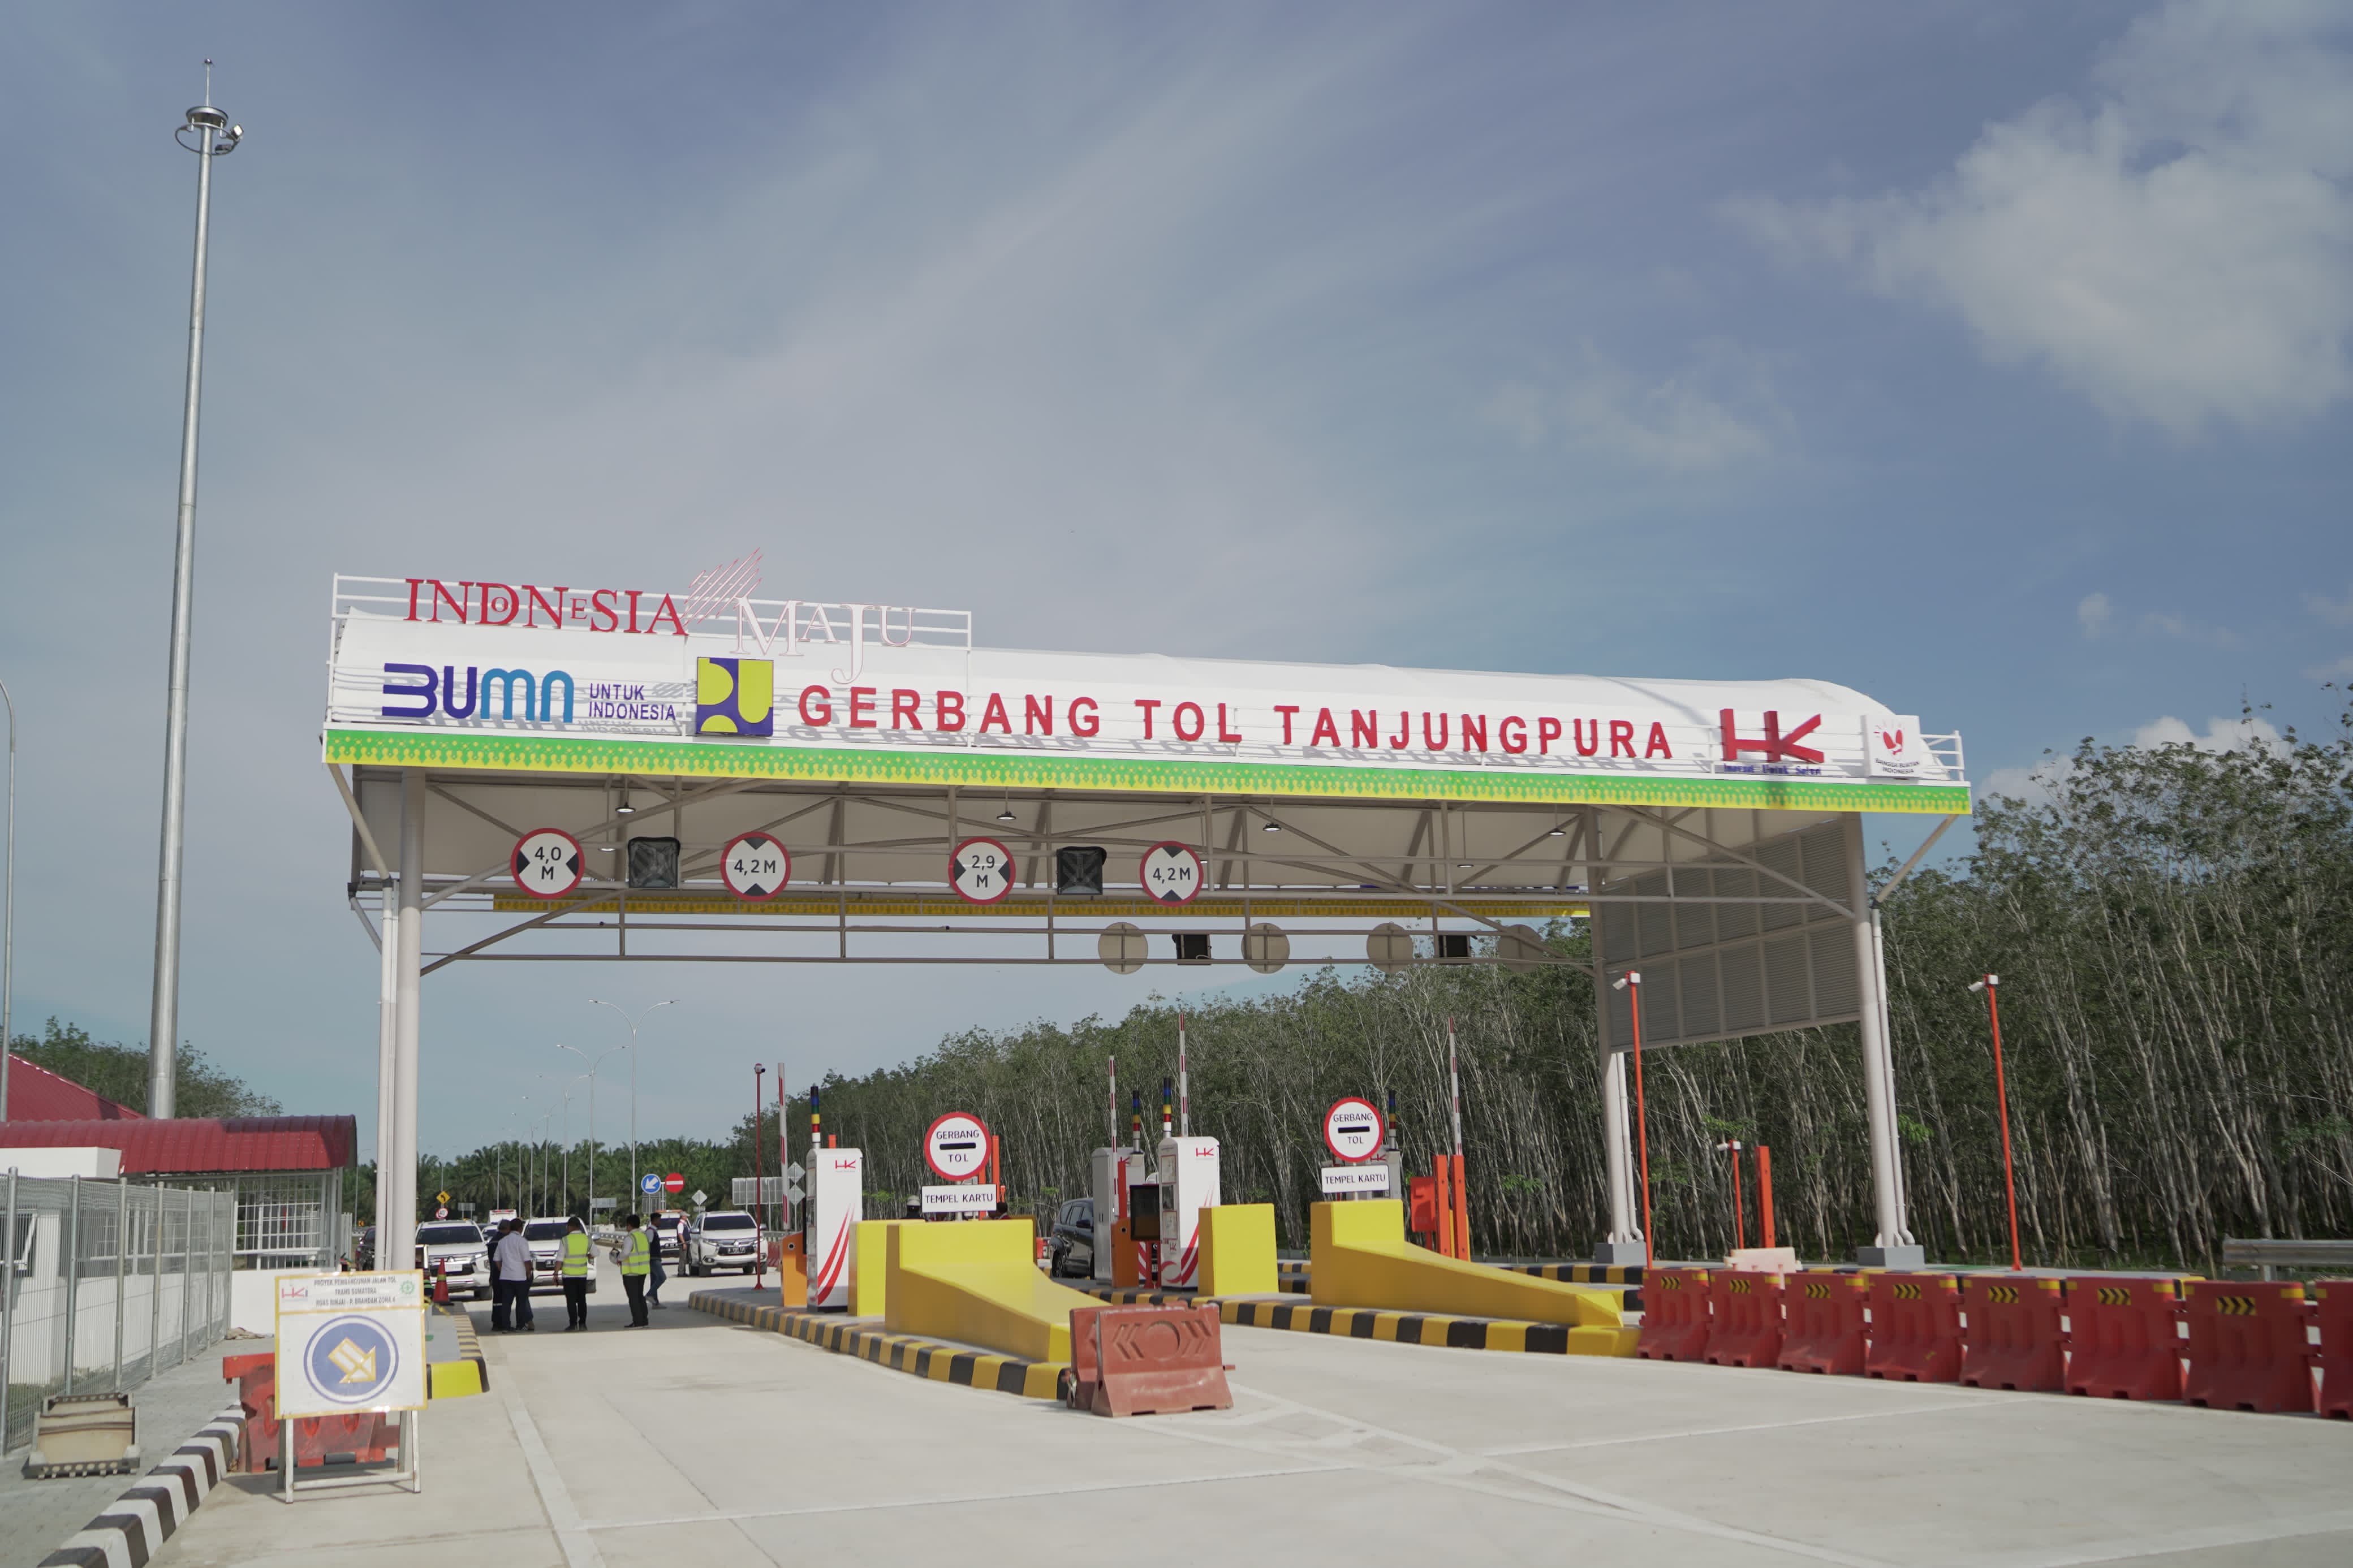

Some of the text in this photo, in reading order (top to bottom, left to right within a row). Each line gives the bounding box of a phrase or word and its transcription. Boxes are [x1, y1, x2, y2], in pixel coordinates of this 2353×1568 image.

[403, 578, 916, 684] INDONESIA MAJU
[589, 683, 645, 701] UNTUK
[589, 701, 676, 720] INDONESIA
[798, 685, 1673, 759] GERBANG TOL TANJUNGPURA
[1720, 709, 1824, 763] HK
[535, 847, 561, 865] 4,0
[972, 855, 995, 870] 2,9
[541, 866, 554, 880] M
[977, 874, 988, 888] M
[1333, 1112, 1373, 1122] GERBANG
[936, 1130, 980, 1140] GERBANG
[1347, 1136, 1364, 1144] TOL
[948, 1154, 968, 1162] TOL
[1195, 1147, 1214, 1157] HK
[835, 1160, 856, 1169] HK
[1325, 1173, 1385, 1185] TEMPEL KARTU
[925, 1193, 993, 1203] TEMPEL KARTU
